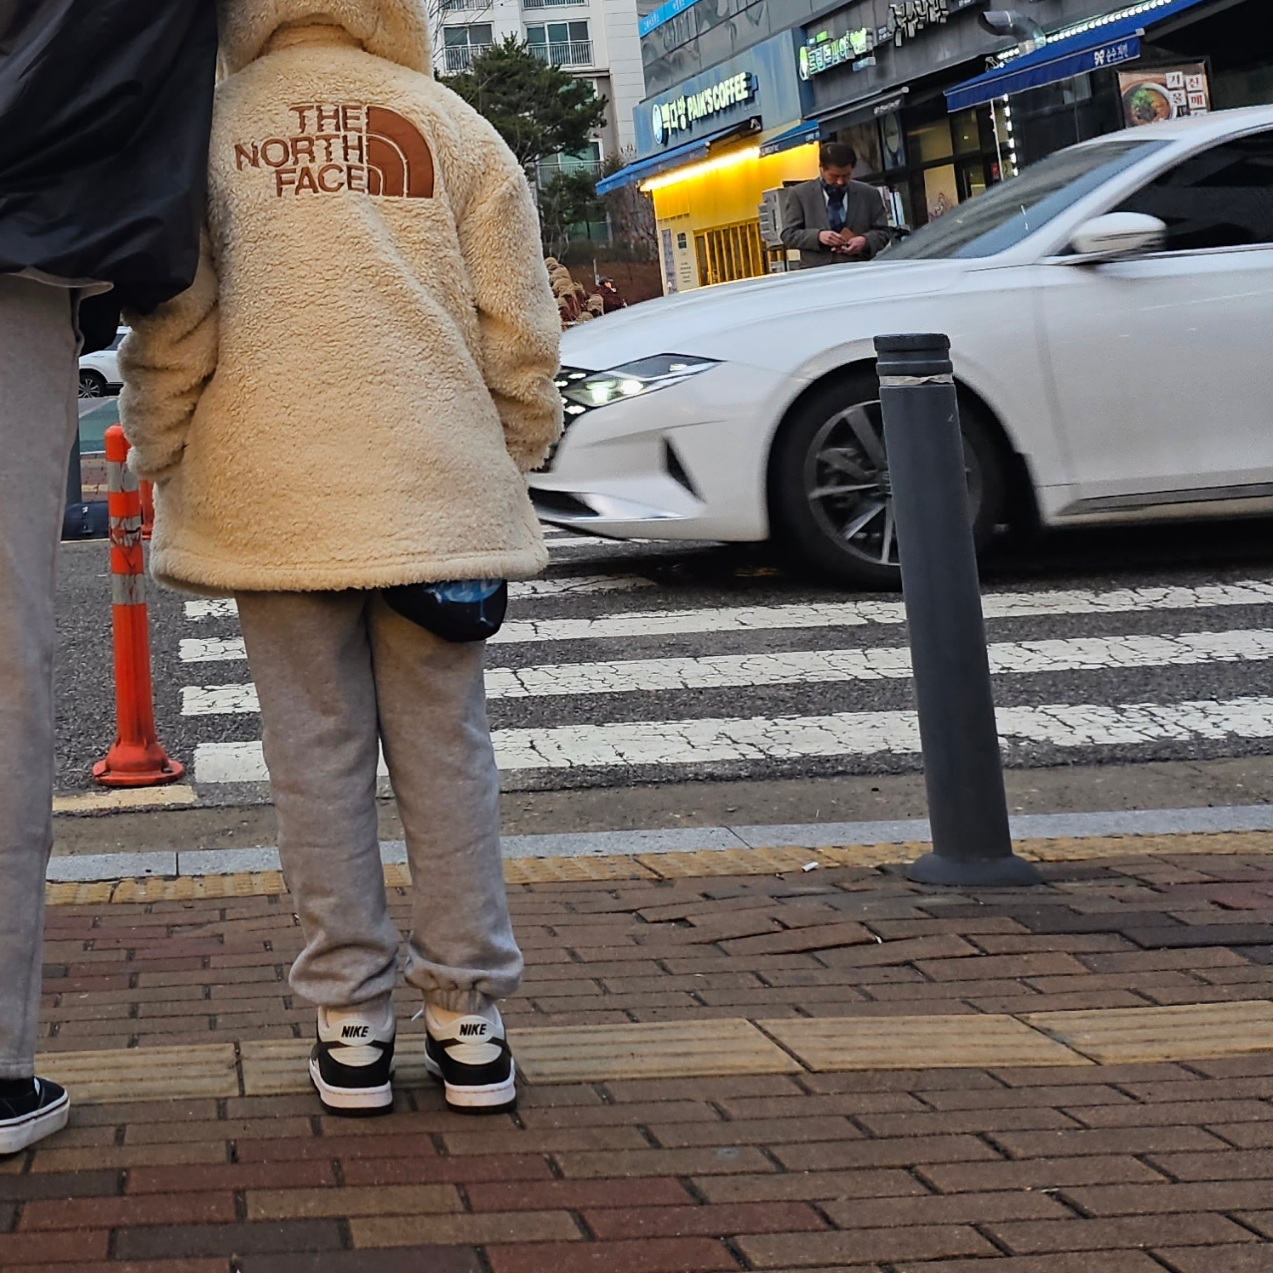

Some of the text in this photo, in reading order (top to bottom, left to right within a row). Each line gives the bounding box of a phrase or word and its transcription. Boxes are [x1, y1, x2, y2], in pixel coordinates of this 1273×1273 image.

[713, 71, 749, 111] COFFEE
[289, 105, 363, 135] THE
[234, 133, 365, 170] NORTH
[275, 164, 365, 197] FACE
[341, 1024, 369, 1039] NIKE
[459, 1022, 486, 1037] NIKE
